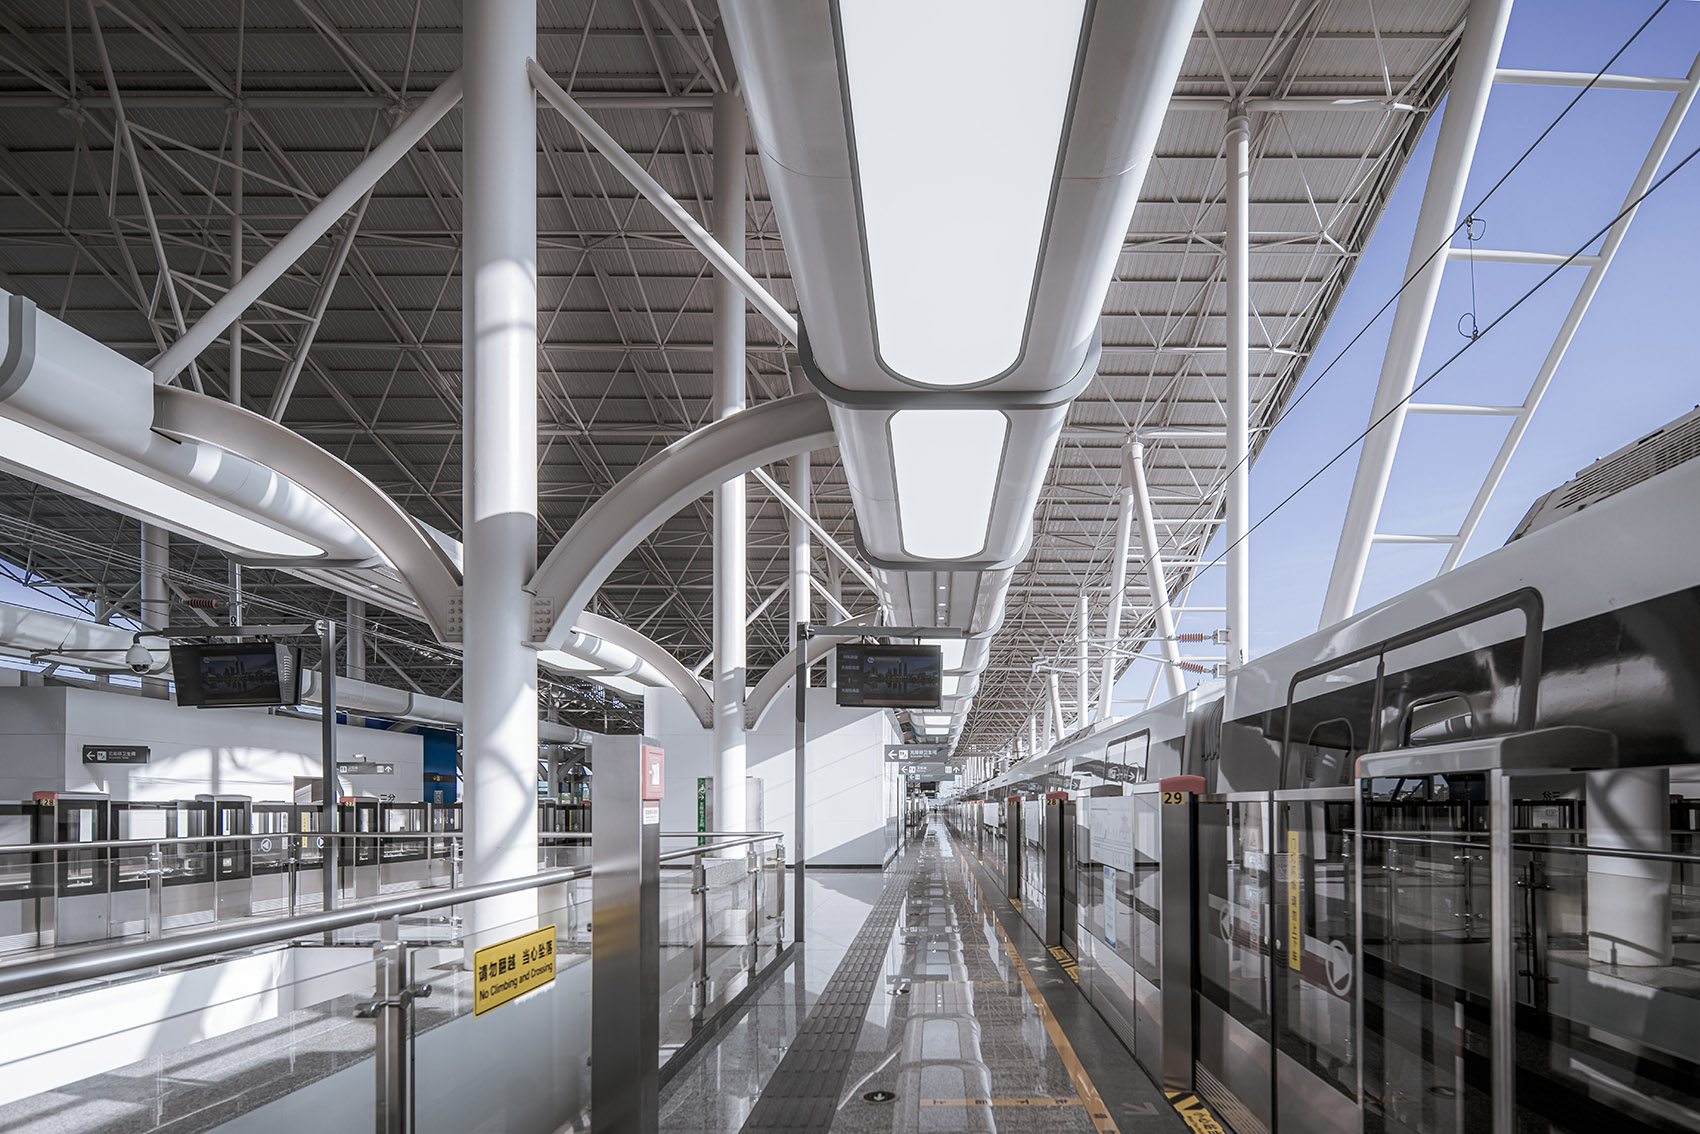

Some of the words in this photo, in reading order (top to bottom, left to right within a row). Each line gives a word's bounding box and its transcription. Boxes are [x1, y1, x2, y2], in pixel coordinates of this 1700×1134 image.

[1164, 792, 1182, 804] 29
[479, 954, 516, 982] 请勿翻越
[522, 940, 553, 965] 当心坠落
[480, 989, 489, 1001] No
[490, 977, 518, 996] Climbing
[519, 971, 530, 984] and
[531, 962, 553, 978] Crossing
